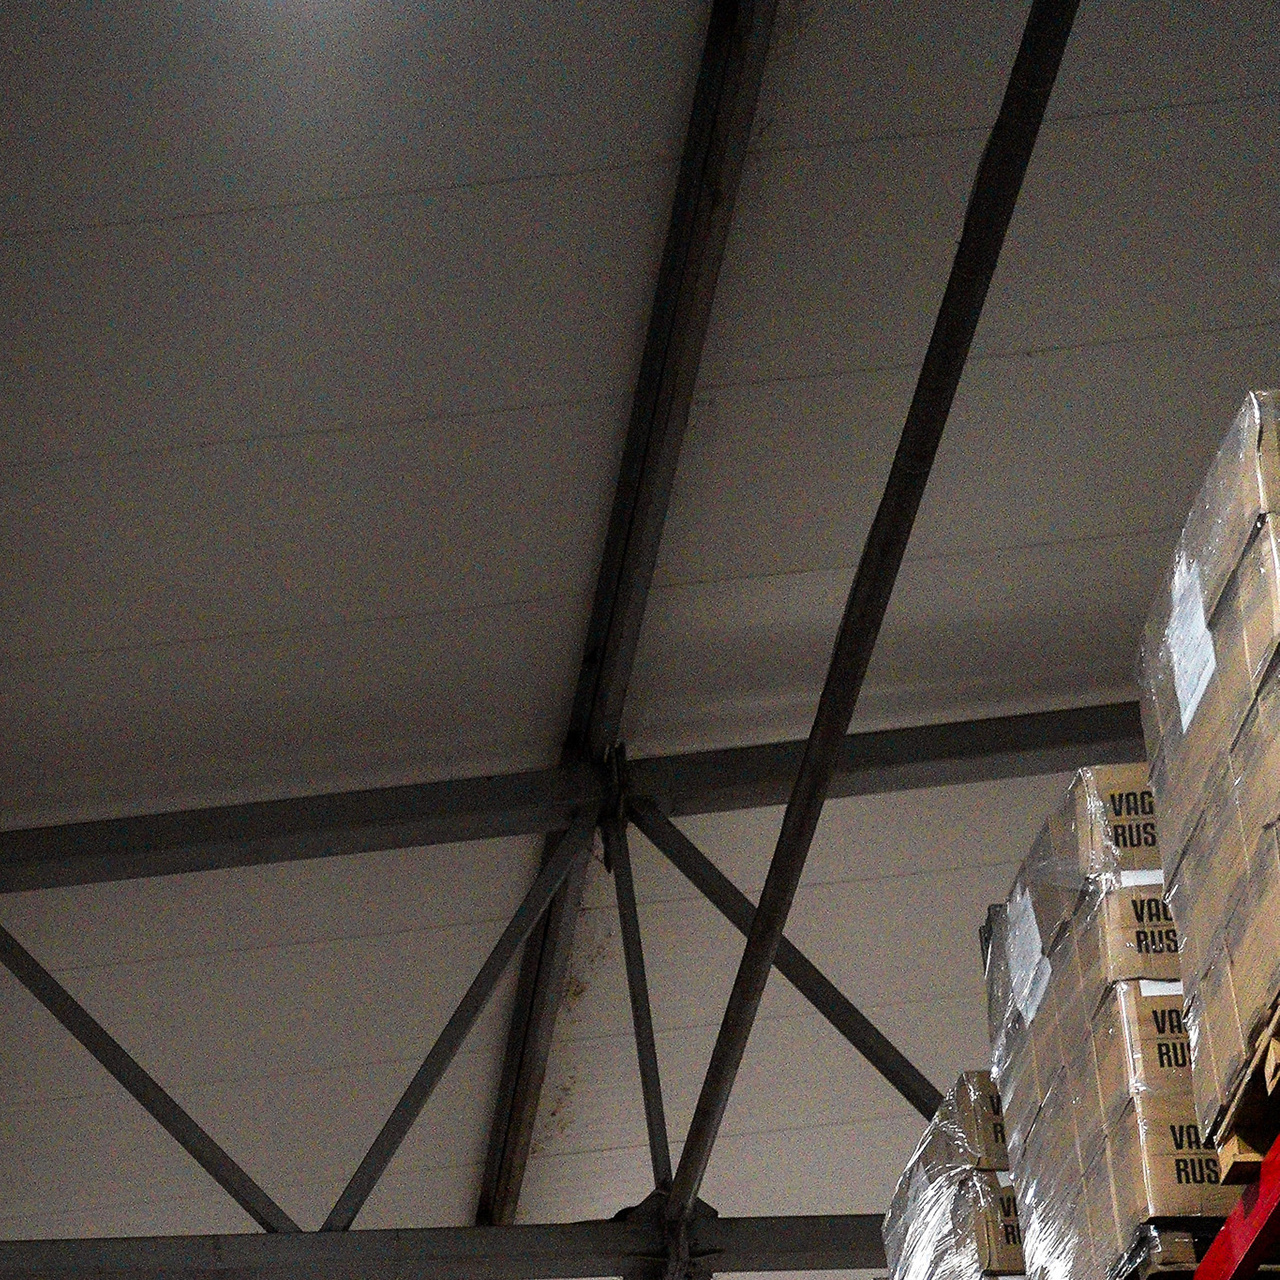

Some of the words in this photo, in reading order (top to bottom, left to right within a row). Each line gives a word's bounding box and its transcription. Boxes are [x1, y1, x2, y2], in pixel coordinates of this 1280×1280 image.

[1110, 791, 1154, 816] VAG
[1113, 823, 1156, 847] RUS
[1136, 929, 1179, 953] RUS
[1152, 1009, 1189, 1034] VA
[1157, 1042, 1191, 1068] RU
[1170, 1125, 1215, 1149] VA
[1175, 1159, 1220, 1184] RUS
